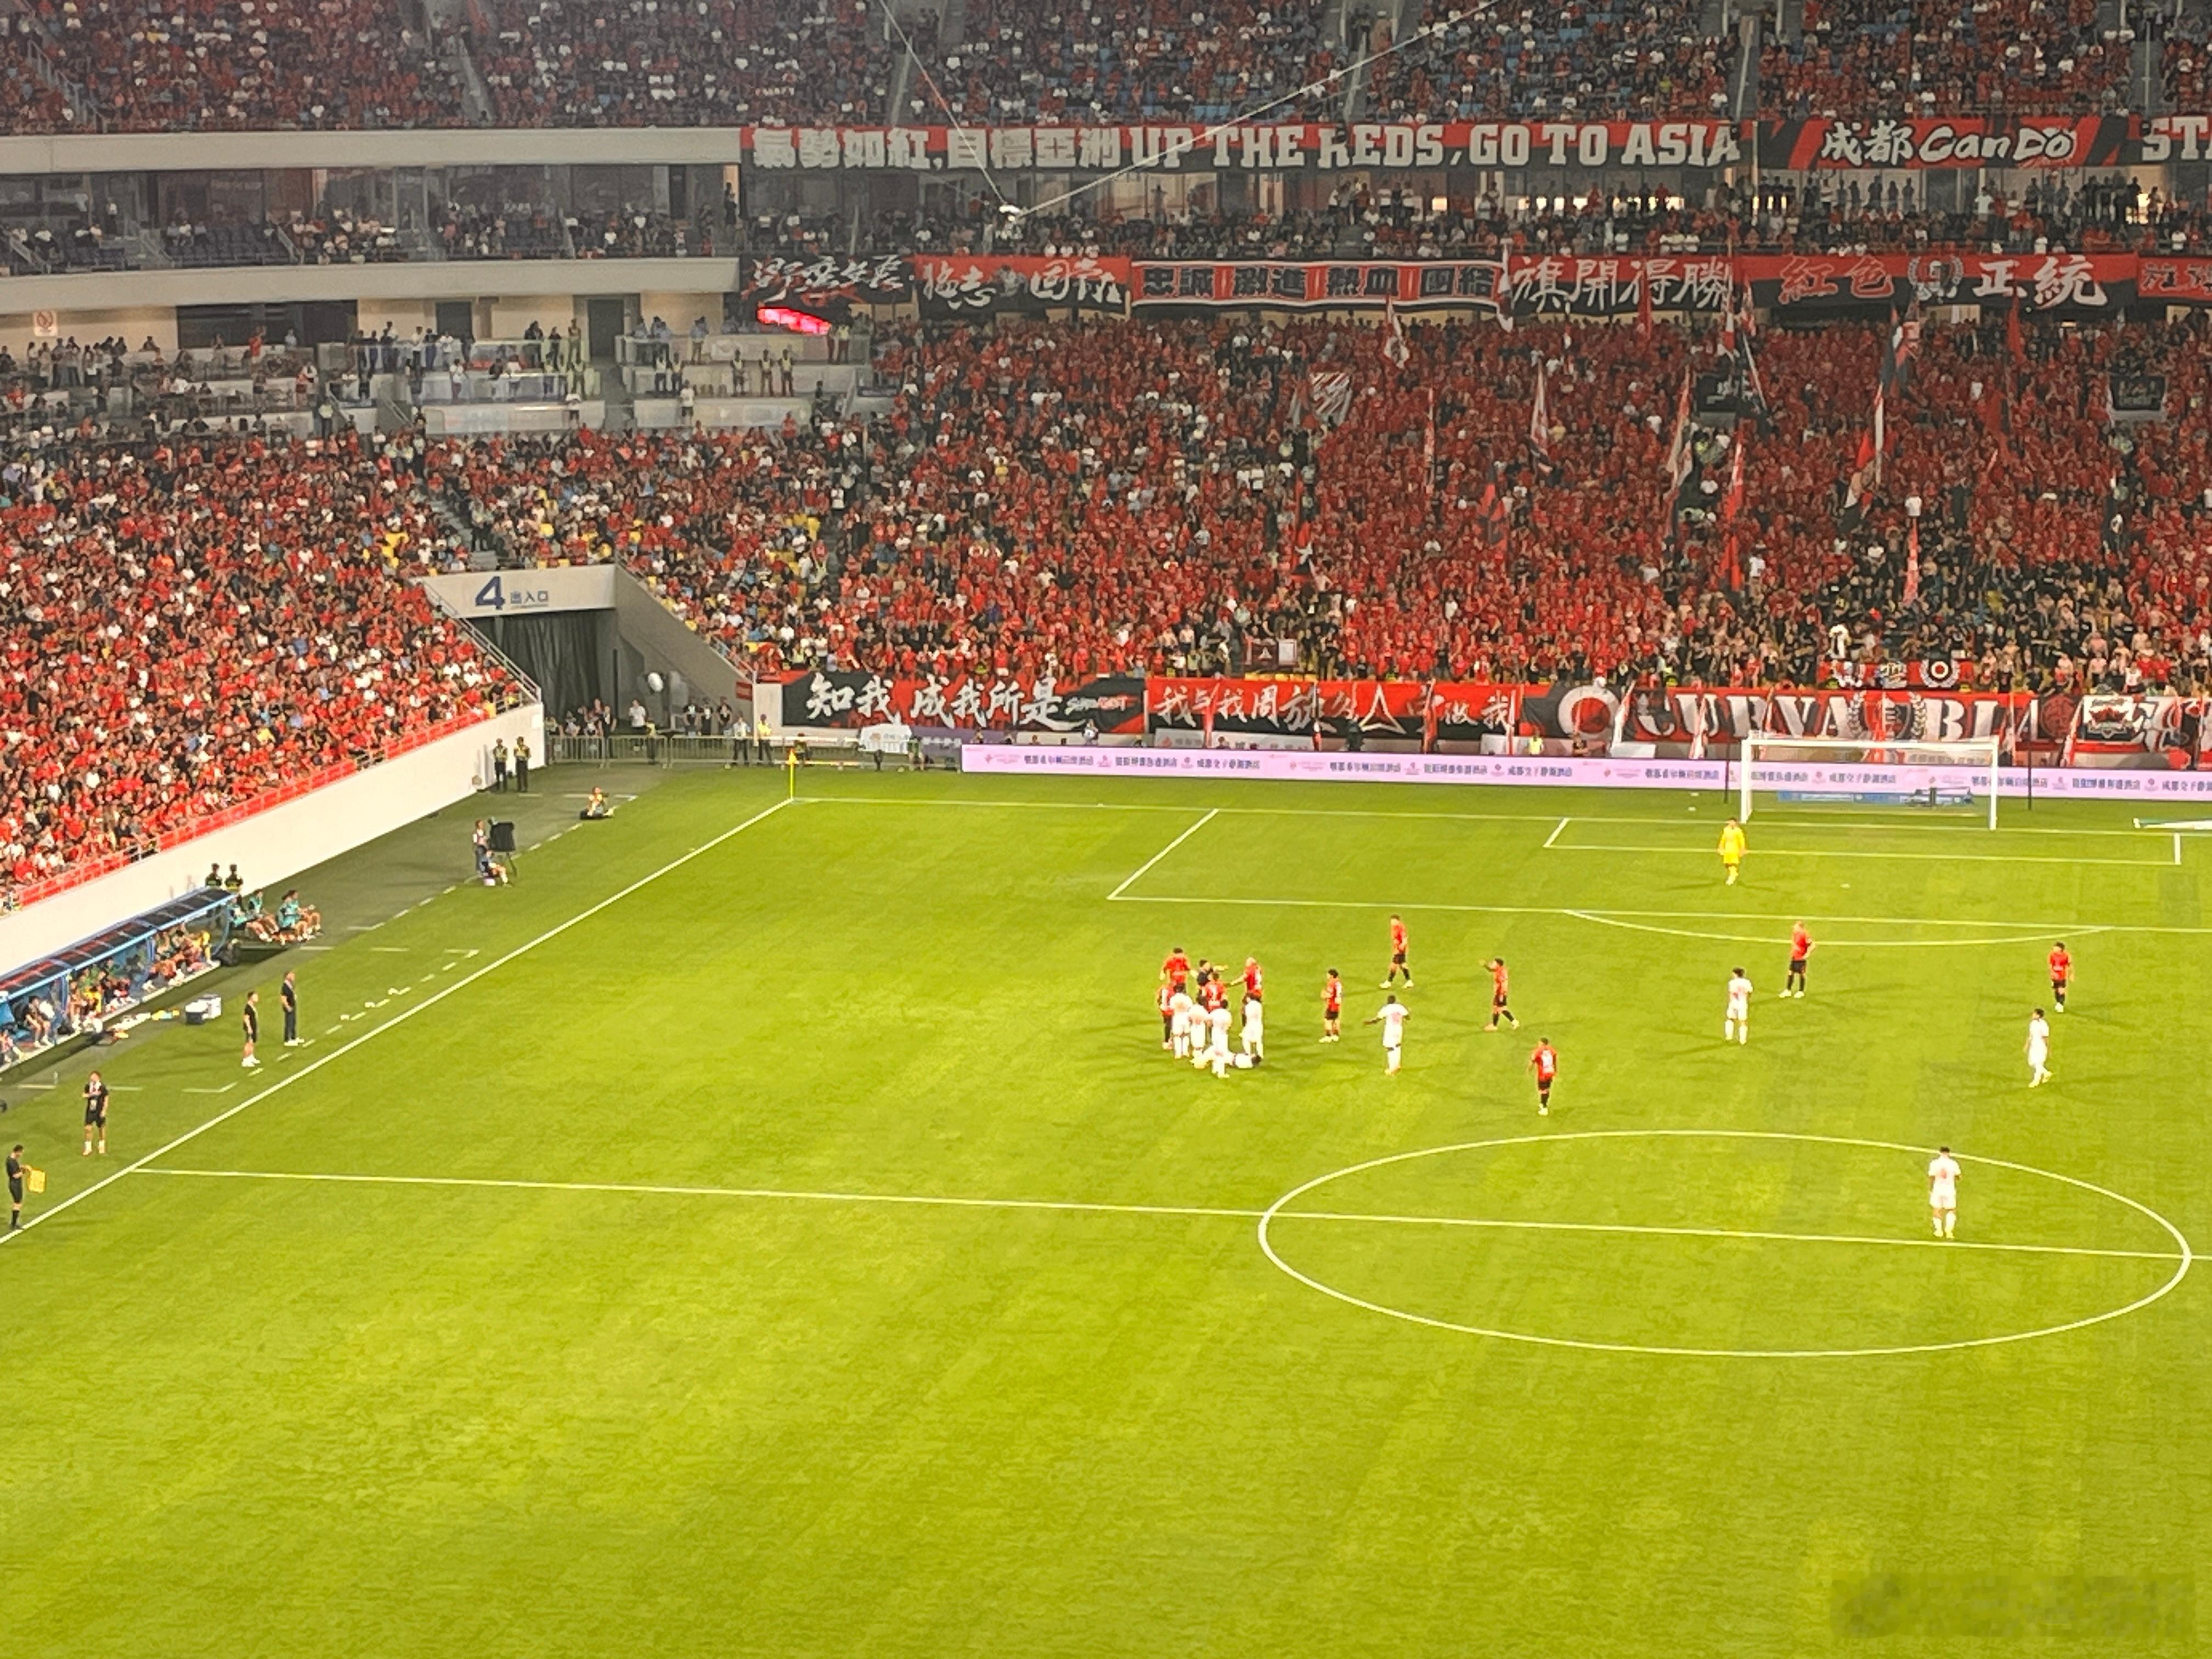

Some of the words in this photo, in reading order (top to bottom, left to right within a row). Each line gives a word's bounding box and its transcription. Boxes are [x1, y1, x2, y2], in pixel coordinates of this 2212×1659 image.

[1130, 127, 1194, 168] UP
[1207, 126, 1305, 167] THE
[1470, 124, 1531, 166] GO
[1542, 124, 1608, 166] TO
[1621, 123, 1741, 167] ASIA
[1821, 119, 1914, 166] 成都
[2142, 116, 2212, 161] ST
[1512, 256, 1733, 312] 旗開得勝
[1779, 256, 1895, 304] 紅色
[1972, 254, 2107, 310] 正統
[474, 575, 506, 611] 4
[510, 590, 549, 603] 出入口
[806, 672, 902, 727] 知我
